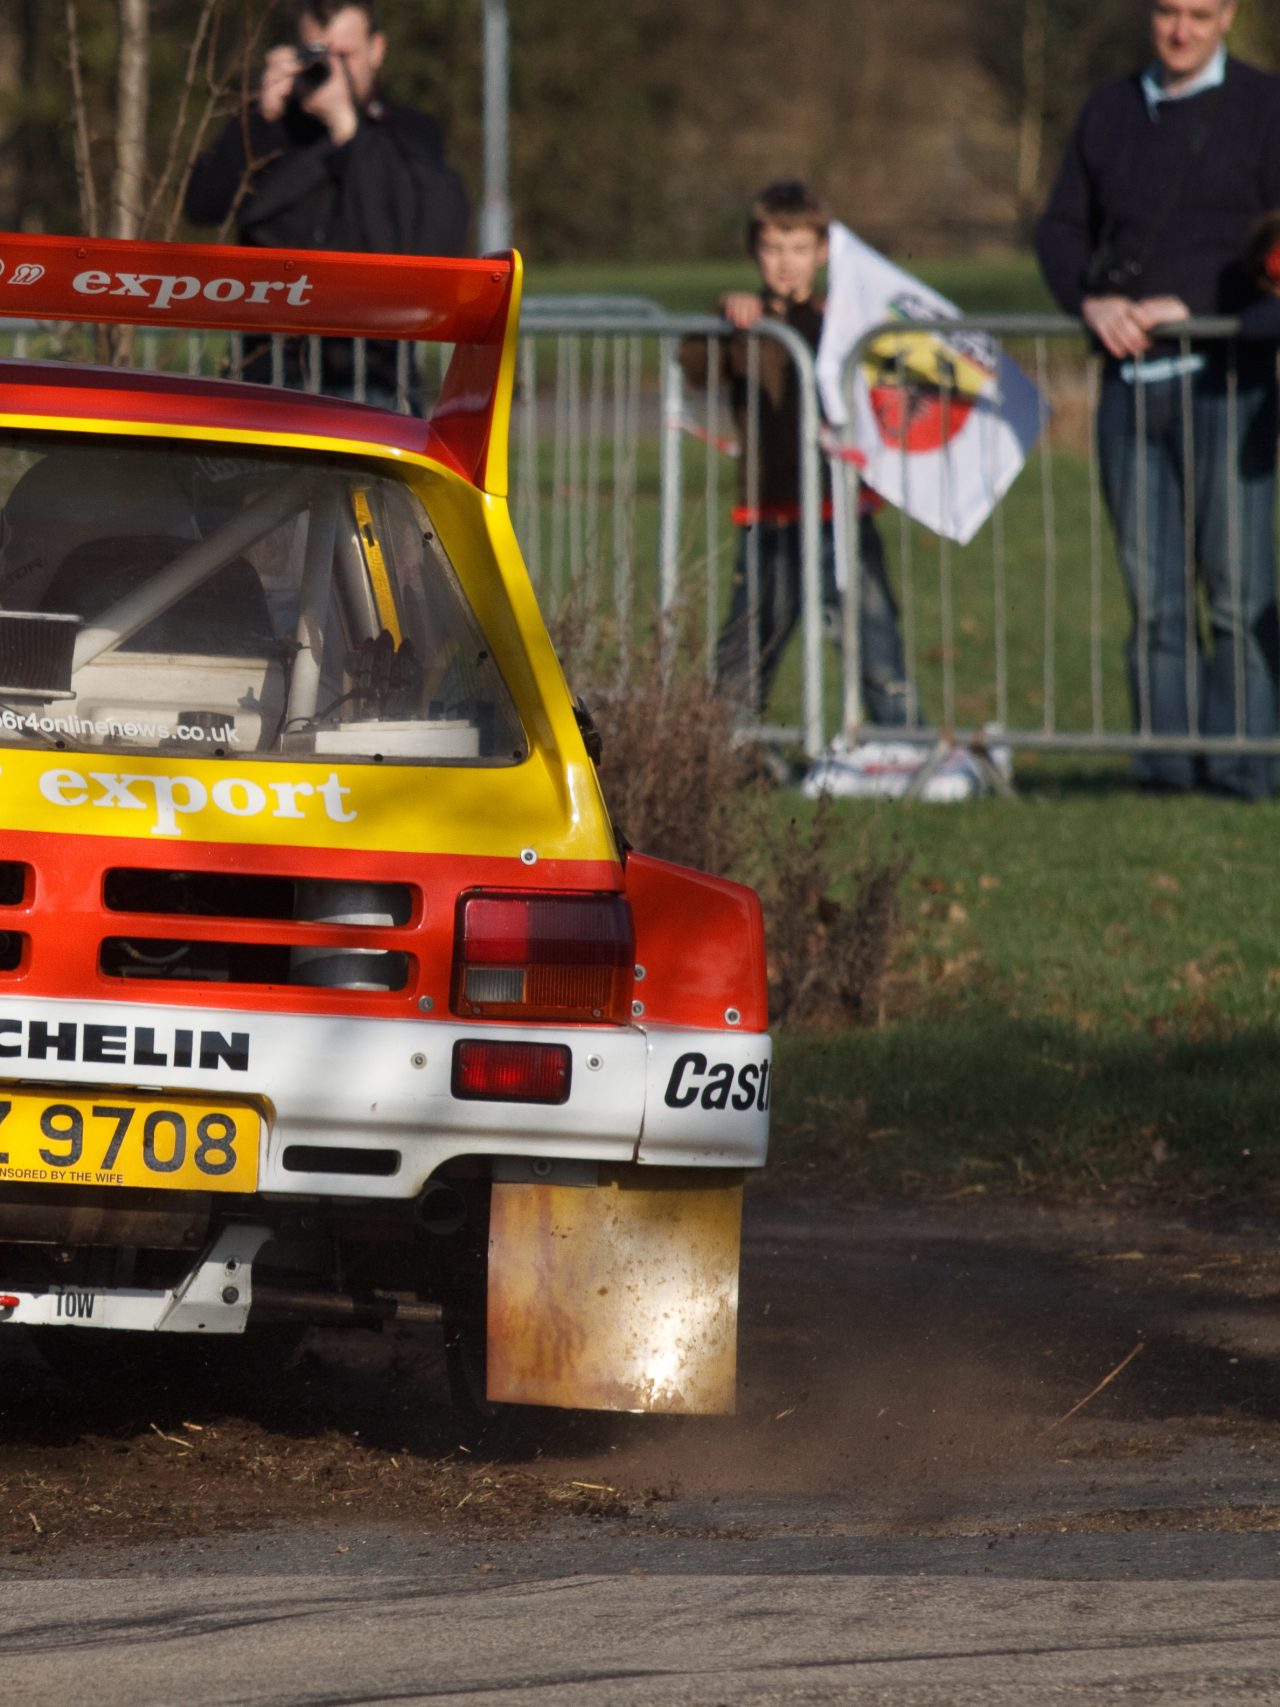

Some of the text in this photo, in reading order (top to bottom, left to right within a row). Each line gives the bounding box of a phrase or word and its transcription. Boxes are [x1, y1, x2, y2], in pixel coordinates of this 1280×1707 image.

[72, 268, 314, 309] export
[38, 768, 358, 837] export
[38, 1105, 238, 1175] 9708
[50, 1171, 67, 1181] BY
[69, 1171, 92, 1182] THE
[94, 1173, 124, 1184] WIFE
[55, 1291, 95, 1318] TOW
